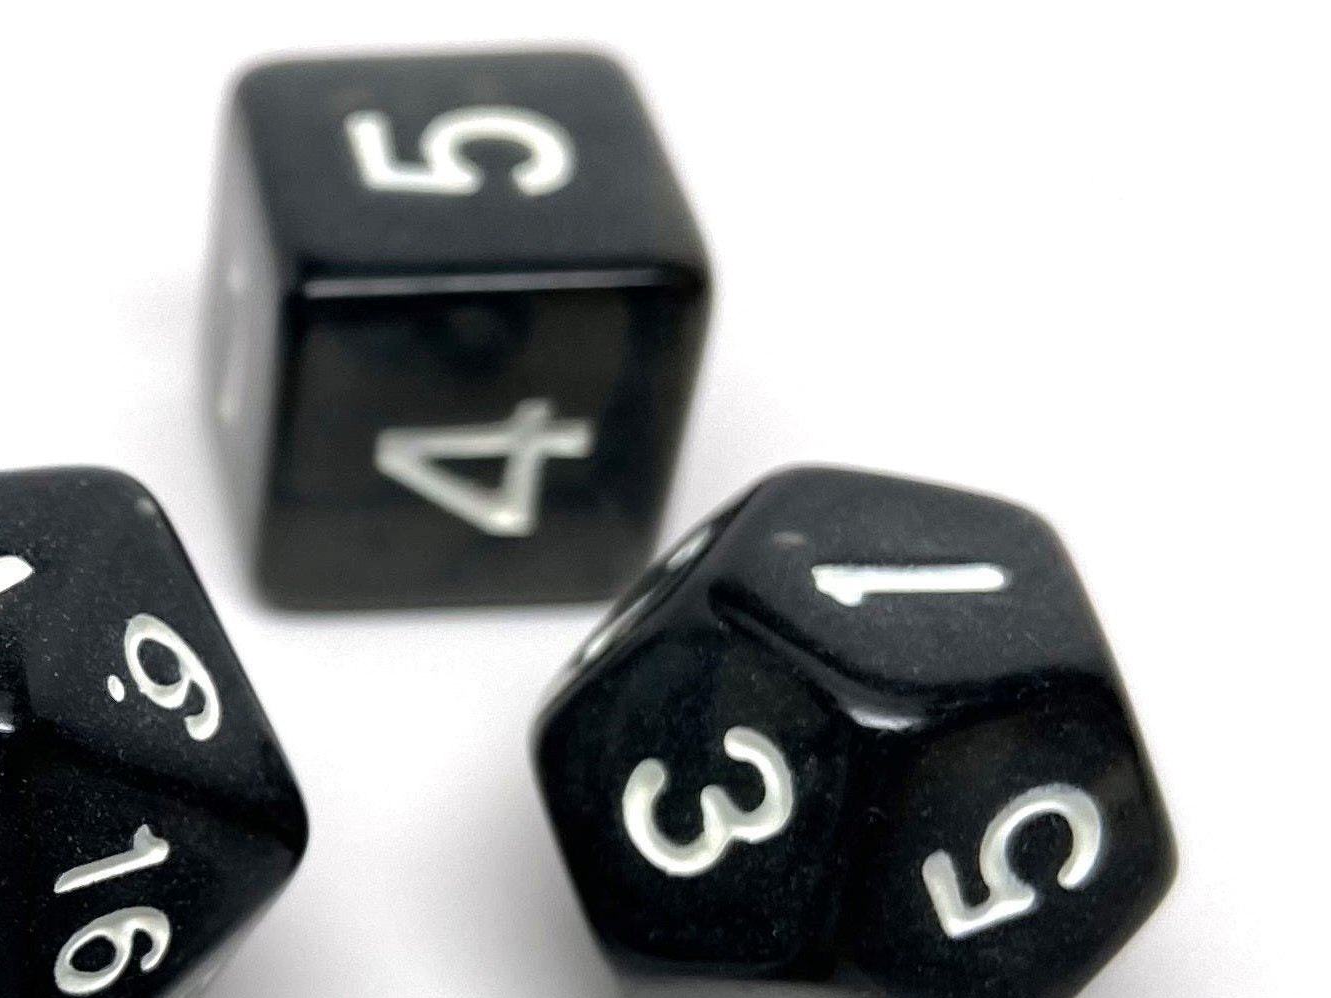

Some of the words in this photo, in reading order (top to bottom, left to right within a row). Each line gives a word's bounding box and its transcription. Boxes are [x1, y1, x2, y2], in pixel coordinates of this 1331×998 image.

[346, 107, 574, 195] 5
[376, 403, 590, 536] 4
[812, 564, 1006, 606] 1
[622, 727, 793, 876] 3
[923, 784, 1102, 938] 5
[54, 825, 170, 994] 16
